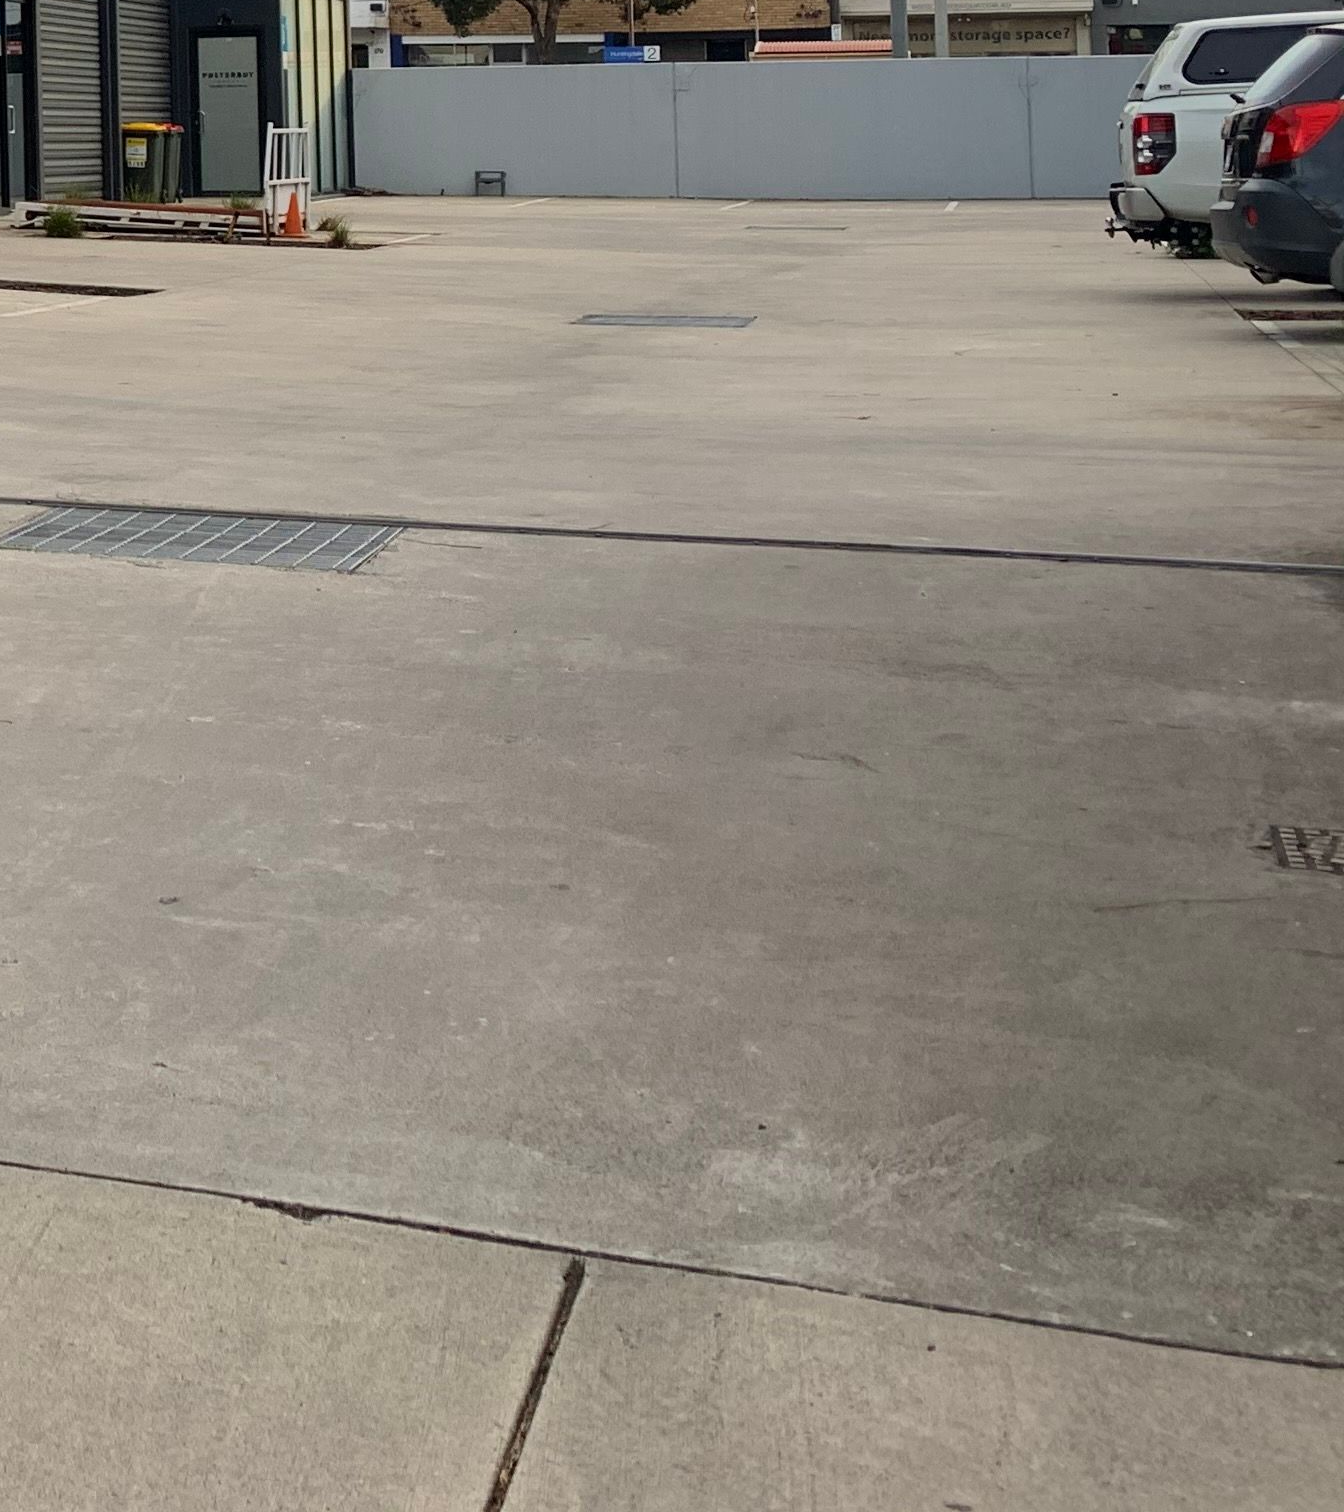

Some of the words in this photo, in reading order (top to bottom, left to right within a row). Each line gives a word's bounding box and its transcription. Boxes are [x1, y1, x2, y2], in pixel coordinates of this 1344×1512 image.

[858, 31, 894, 40] Nee
[951, 29, 1011, 43] storage
[1015, 27, 1071, 42] space?
[647, 47, 657, 59] 2
